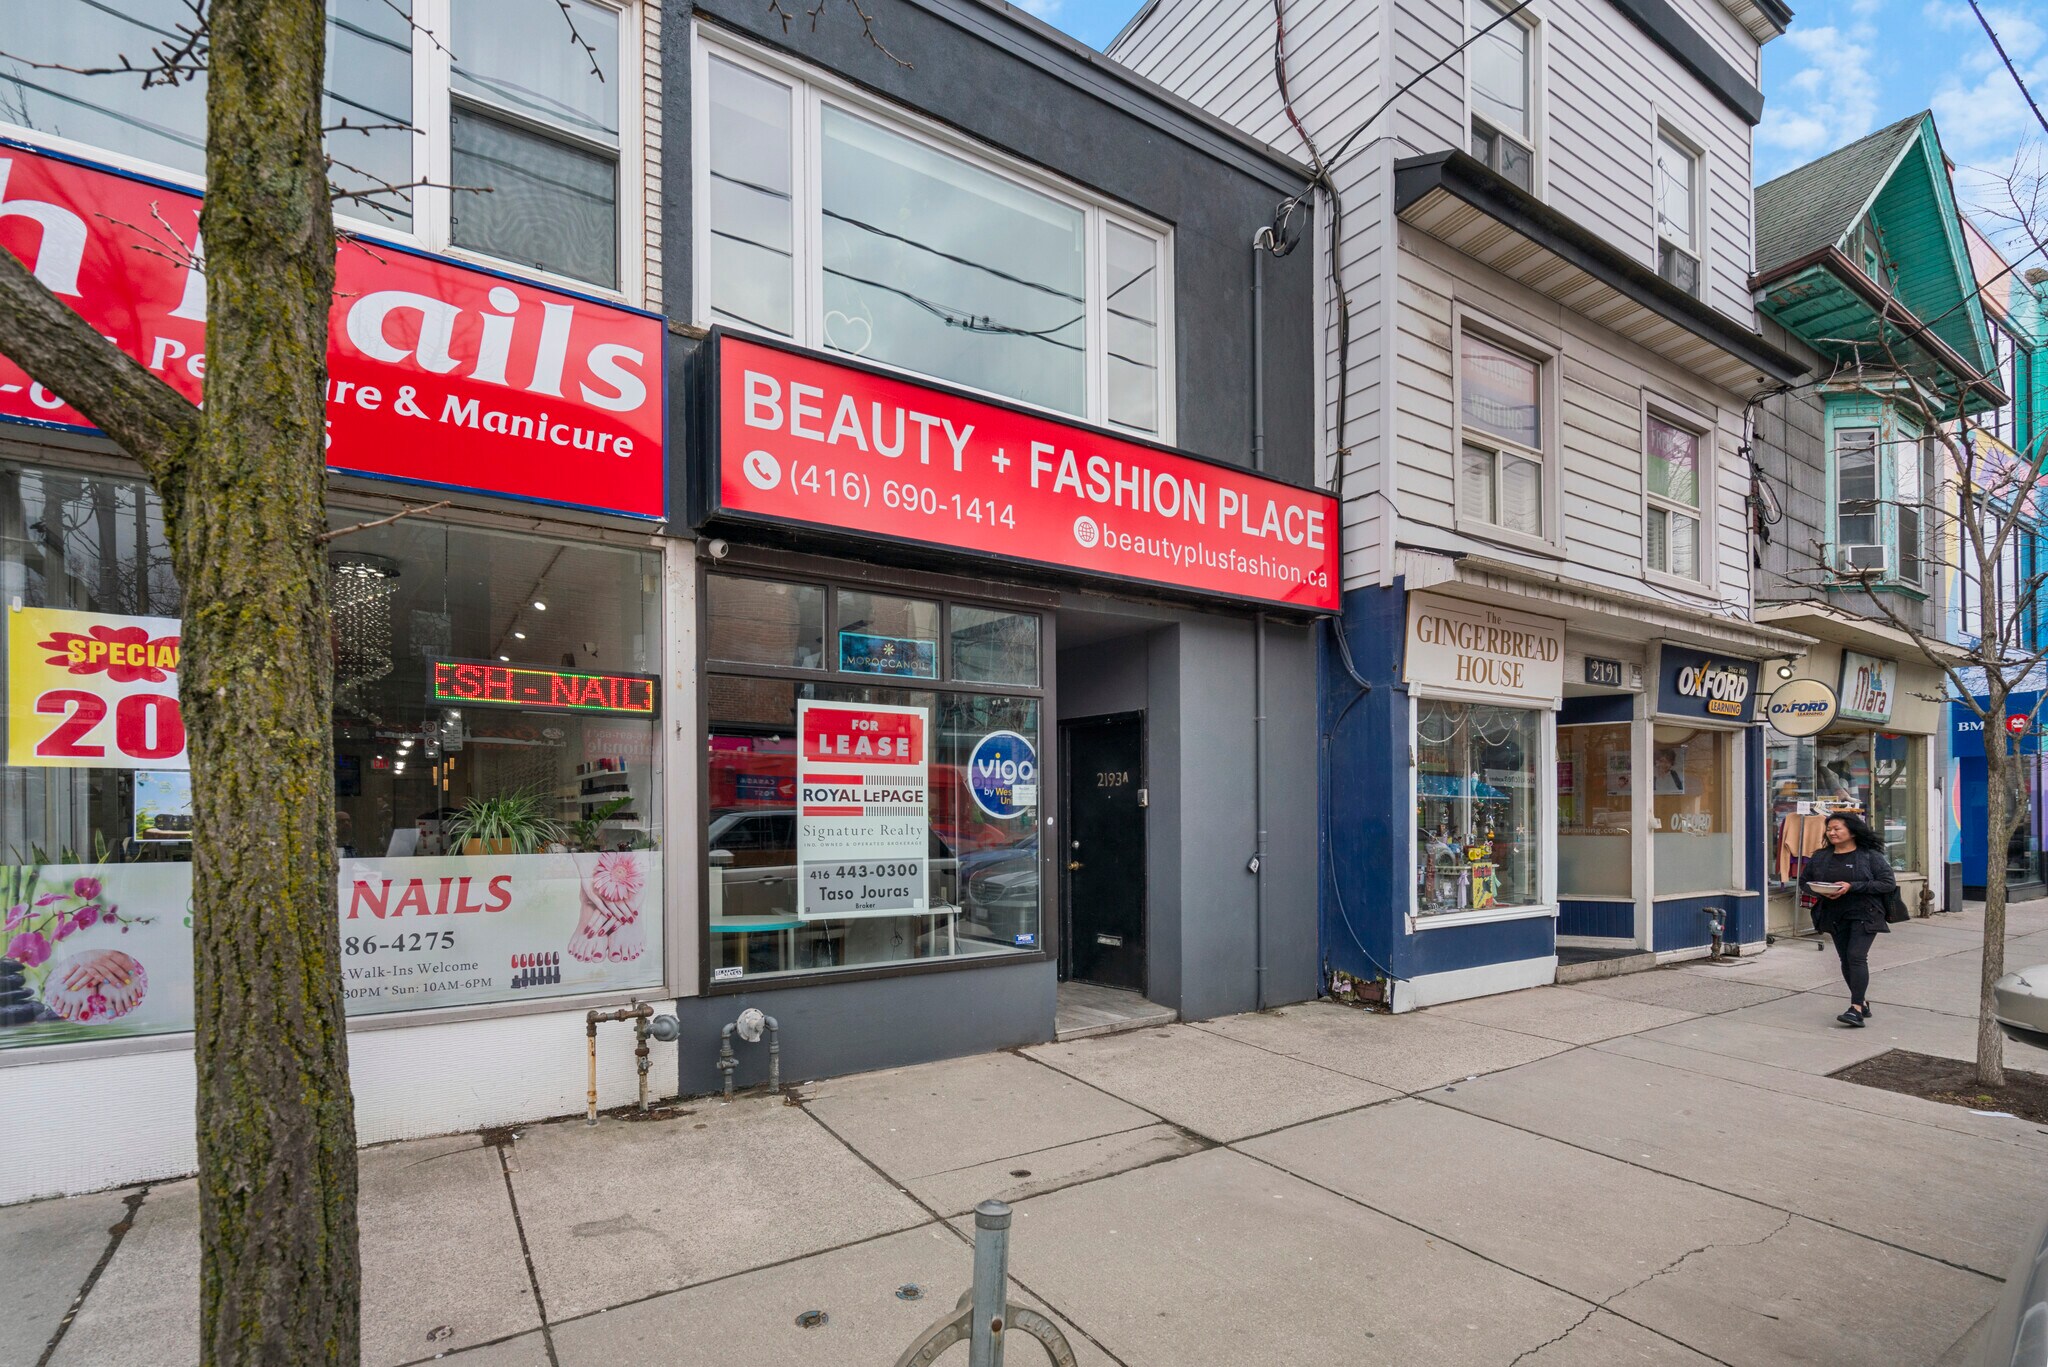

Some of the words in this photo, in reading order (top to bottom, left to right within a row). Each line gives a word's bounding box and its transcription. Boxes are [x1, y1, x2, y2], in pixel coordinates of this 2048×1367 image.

[393, 385, 431, 420] &
[439, 394, 634, 458] Manicure
[1471, 392, 1523, 433] WRITING
[744, 369, 975, 472] BEAUTY
[992, 448, 1010, 473] +
[1030, 440, 1206, 525] FASHION
[1218, 487, 1326, 551] PLACE
[790, 460, 871, 508] (416)
[882, 480, 1016, 530] 690-1414
[1103, 522, 1328, 588] beautyplusfashion.ca
[1485, 611, 1502, 625] The
[1416, 614, 1559, 663] GINGERBREAD
[846, 655, 929, 671] MOROCCANOIL
[1455, 653, 1525, 689] HOUSE
[1591, 661, 1620, 684] 2191
[1678, 661, 1749, 703] OXFORD
[1852, 666, 1887, 713] Mara
[1710, 700, 1741, 715] LEARNING
[1771, 699, 1828, 714] OXFORD
[852, 719, 879, 731] FOR
[1957, 720, 1985, 732] BM
[819, 733, 909, 757] LEASE
[977, 752, 1034, 785] vigo
[1096, 771, 1129, 787] 2193A
[803, 788, 861, 802] ROYAL
[984, 787, 994, 797] by
[803, 824, 874, 842] Signature
[880, 823, 923, 840] Realty
[810, 870, 830, 880] 416
[836, 863, 918, 879] 443-0300
[346, 874, 512, 920] NAILS
[819, 886, 854, 901] Taso
[860, 884, 909, 899] Jouras
[343, 931, 455, 957] 86-4275
[348, 965, 414, 980] Walk-Ins
[417, 961, 479, 975] Welcome
[391, 985, 420, 995] Sun:
[423, 977, 493, 993] 10AM-6PM
